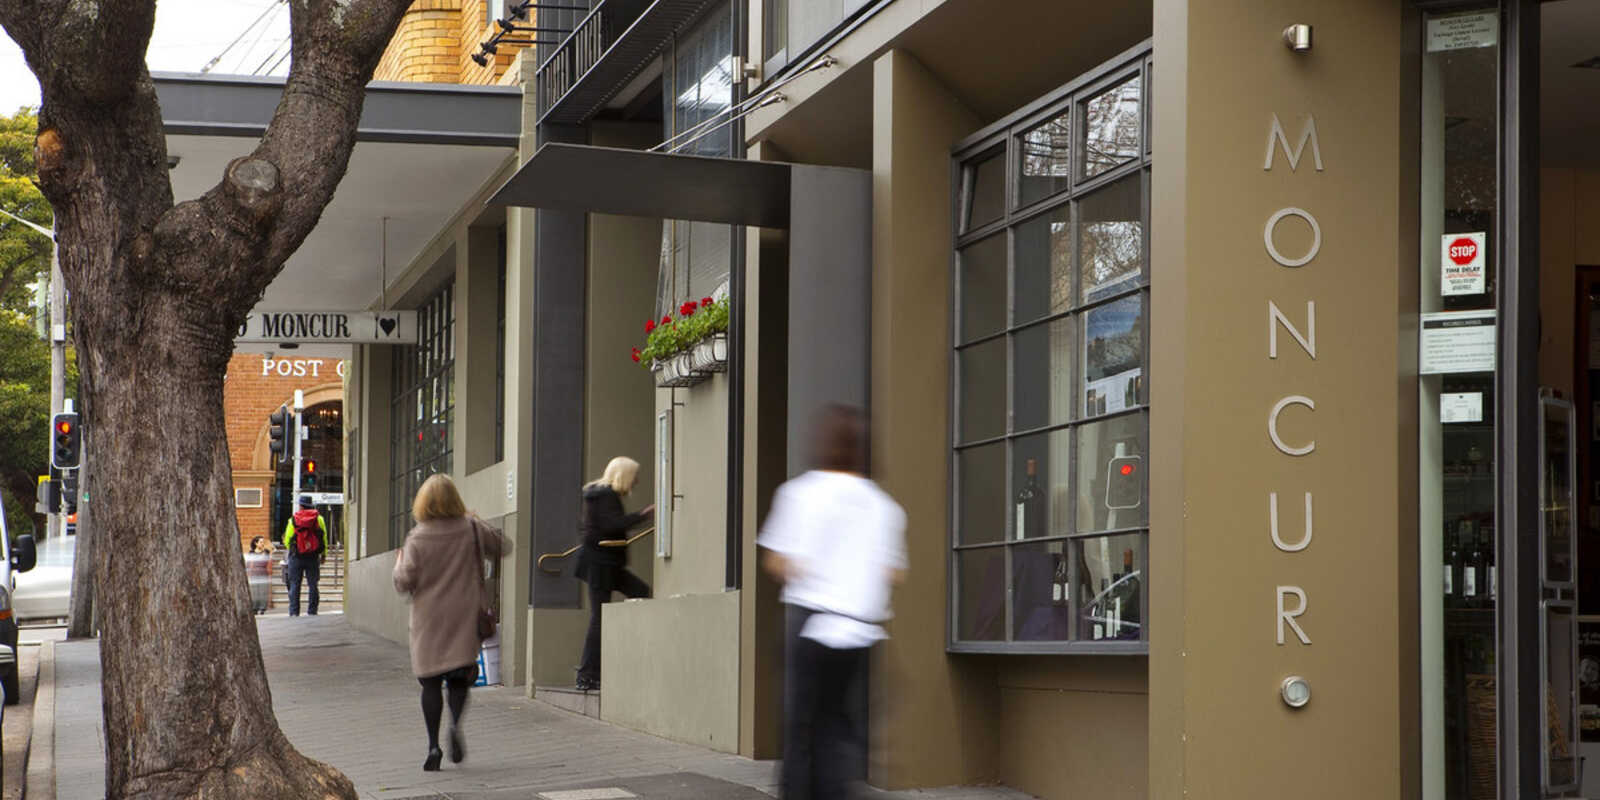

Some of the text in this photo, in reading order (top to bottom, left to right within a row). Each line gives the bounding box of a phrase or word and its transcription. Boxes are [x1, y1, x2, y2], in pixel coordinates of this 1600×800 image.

[1451, 245, 1476, 258] STOP
[262, 313, 351, 338] MONCUR
[262, 359, 323, 377] POST
[1263, 111, 1324, 645] MONCUR
